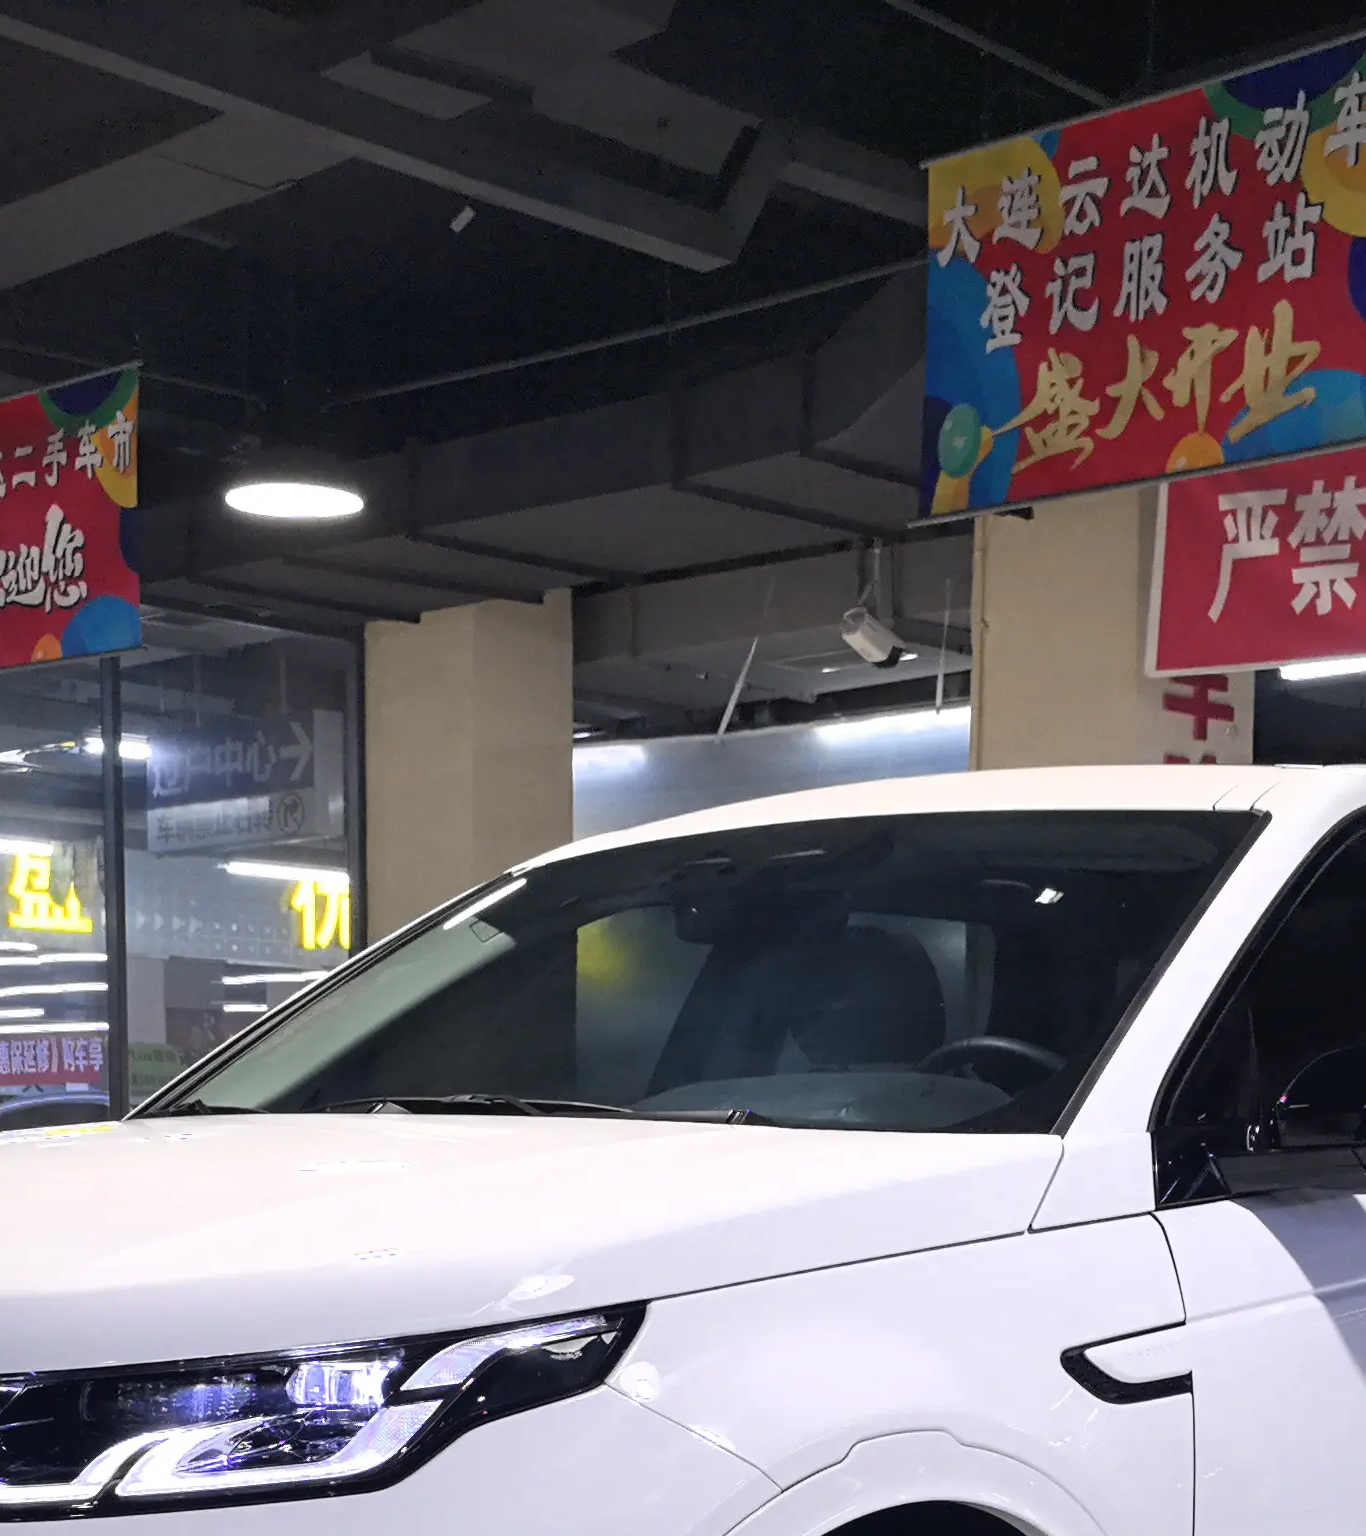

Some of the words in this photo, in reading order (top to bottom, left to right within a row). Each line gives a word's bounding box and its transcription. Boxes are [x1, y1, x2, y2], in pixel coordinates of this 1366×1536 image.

[981, 190, 1324, 353] 登记服务站
[992, 300, 1321, 476] 盛大开业
